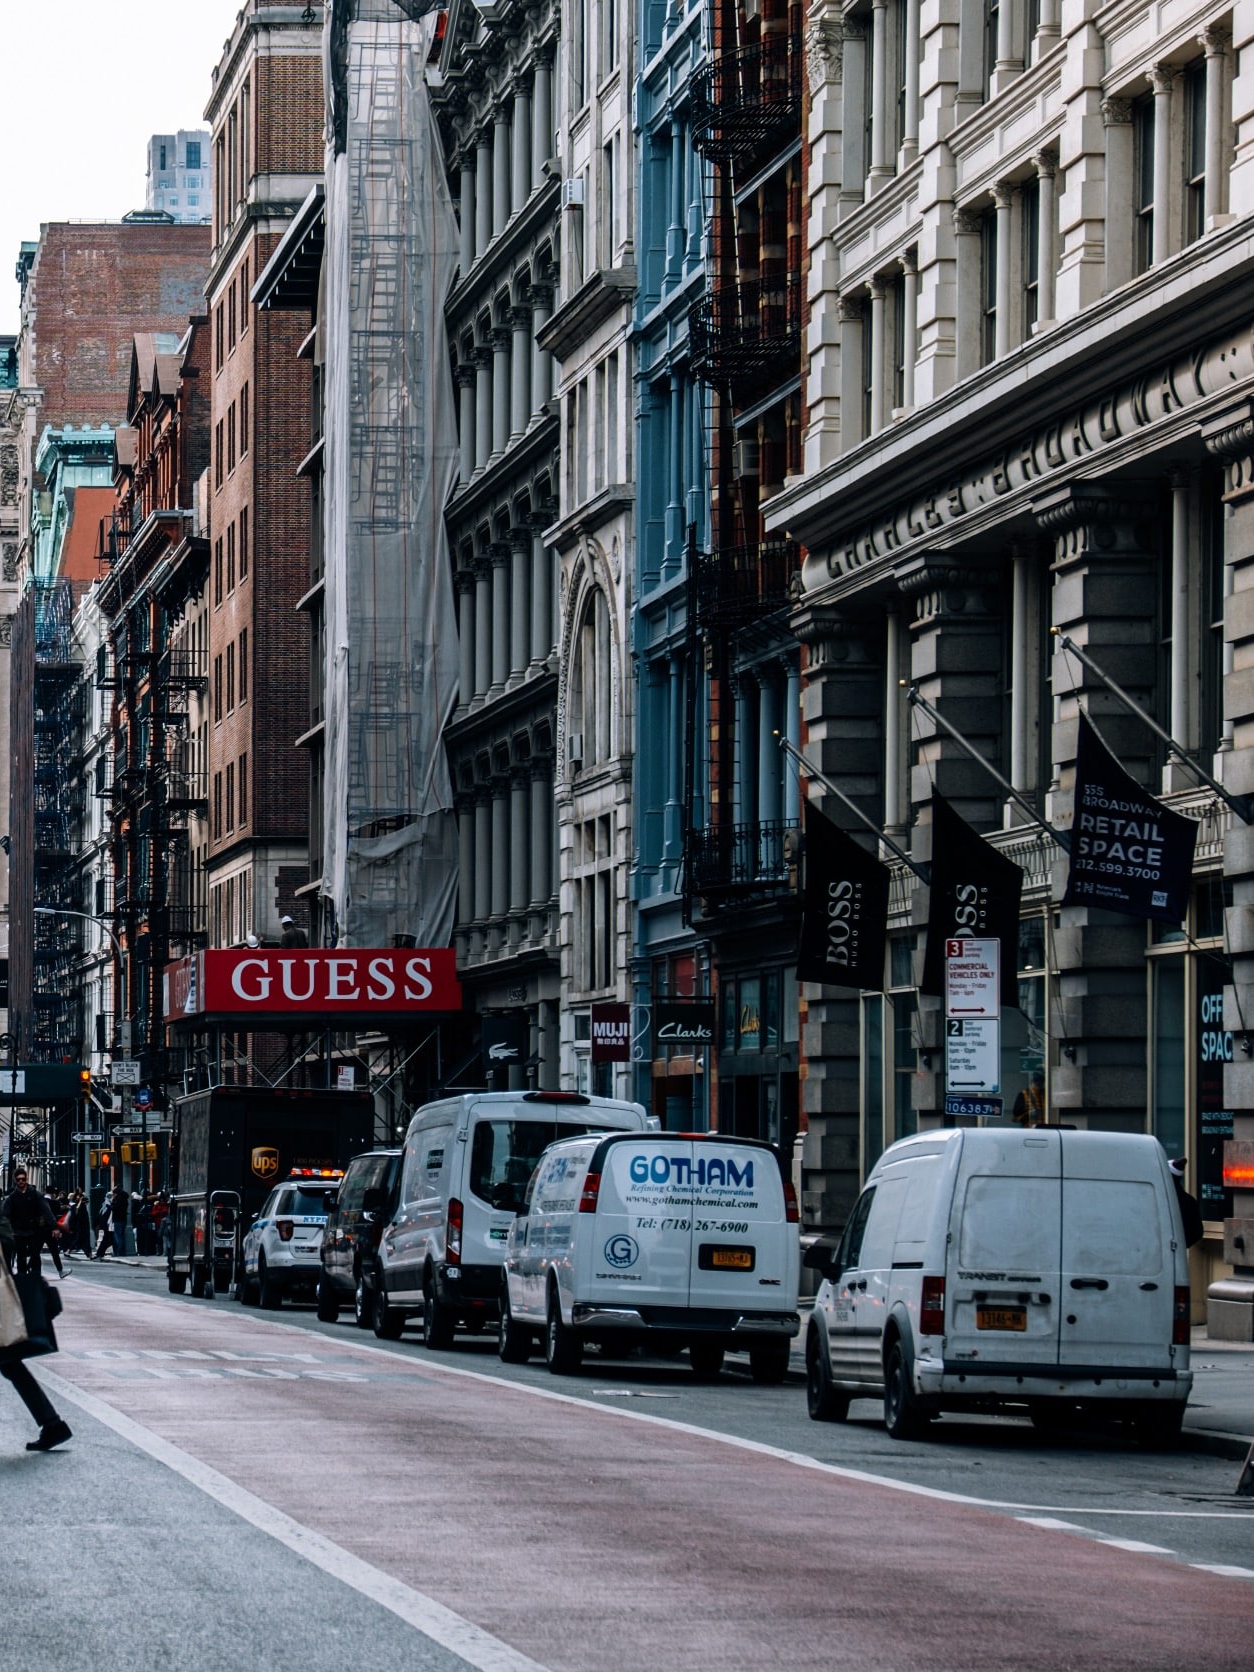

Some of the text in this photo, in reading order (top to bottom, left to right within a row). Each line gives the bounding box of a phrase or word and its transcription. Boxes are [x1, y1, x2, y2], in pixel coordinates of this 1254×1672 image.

[1084, 784, 1105, 796] 555
[1082, 795, 1162, 819] BROADWAY
[1080, 812, 1165, 842] RETAIL
[1078, 837, 1163, 866] SPACE
[1075, 859, 1161, 881] 212.599.3700
[826, 881, 853, 967] BOSS
[851, 930, 859, 967] HUGO
[950, 941, 960, 956] 3
[232, 957, 433, 1001] GUESS
[593, 1022, 628, 1037] MUJI
[657, 1022, 713, 1038] Clarks
[951, 1021, 960, 1036] 2
[1202, 1031, 1234, 1061] SPAC
[253, 1157, 277, 1174] ups
[630, 1155, 754, 1188] GOTHAM
[630, 1184, 754, 1197] Refining Chemical Corporation
[625, 1194, 759, 1209] www.gothamchemical.com
[636, 1217, 749, 1233] Tel: (718) 267-6900
[957, 1271, 1006, 1280] TRANSIT
[144, 1367, 371, 1383] BUS
